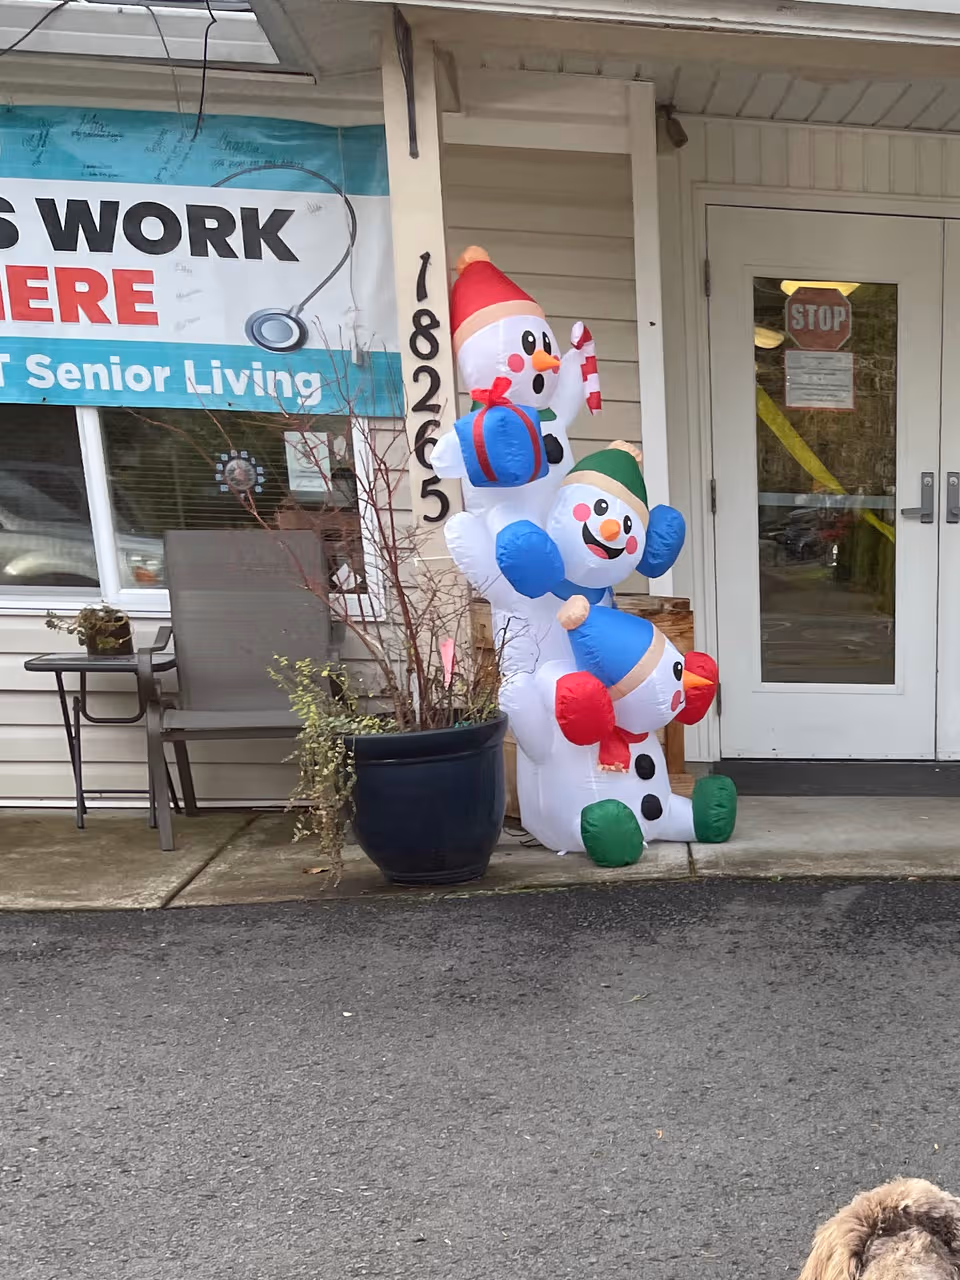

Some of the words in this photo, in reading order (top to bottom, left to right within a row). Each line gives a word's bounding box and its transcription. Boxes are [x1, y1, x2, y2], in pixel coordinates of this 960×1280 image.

[35, 197, 300, 262] WORK
[0, 264, 159, 326] ERE
[791, 304, 847, 331] STOP
[26, 354, 171, 393] Senior
[185, 359, 322, 404] Living
[409, 251, 450, 523] 18265
